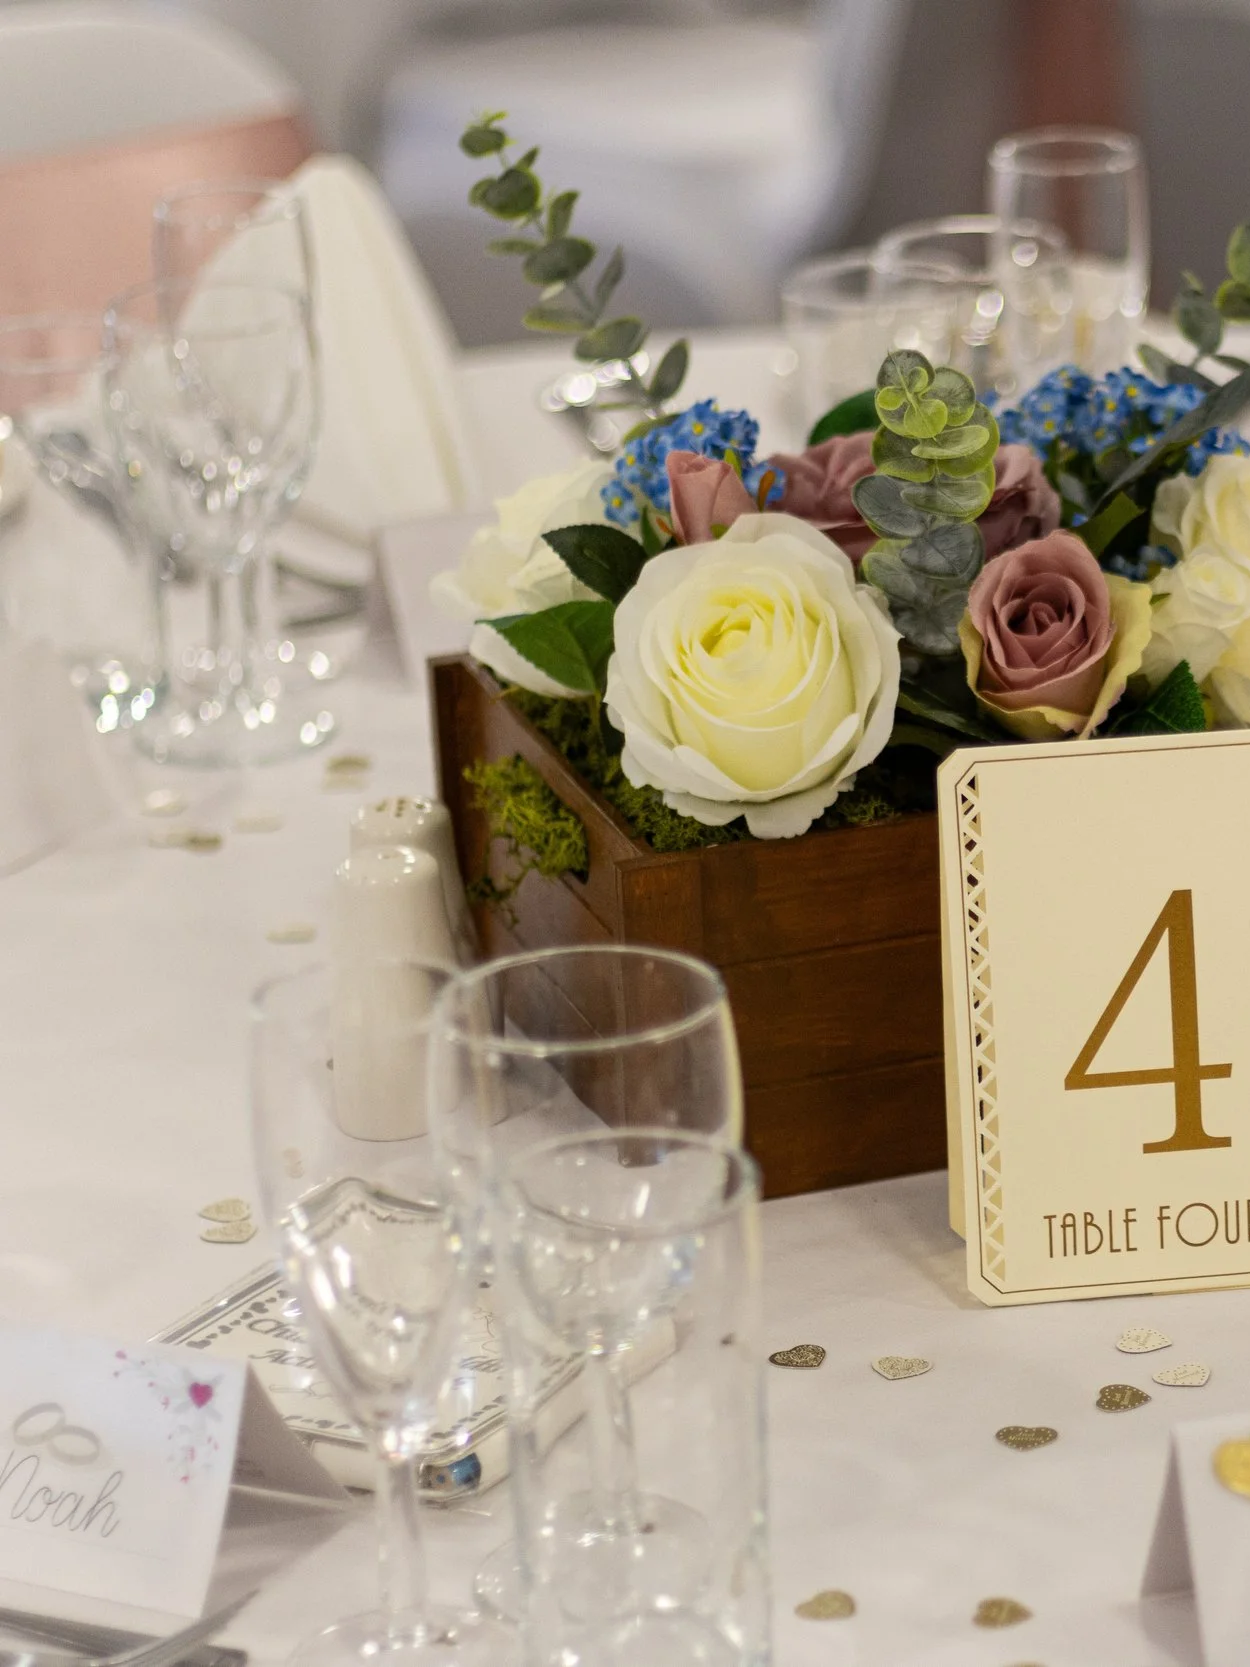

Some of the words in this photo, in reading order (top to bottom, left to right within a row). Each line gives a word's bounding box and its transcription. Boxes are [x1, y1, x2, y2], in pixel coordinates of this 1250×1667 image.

[1064, 888, 1233, 1154] 4
[1043, 1207, 1138, 1259] TABLE
[0, 1449, 123, 1538] Noah
